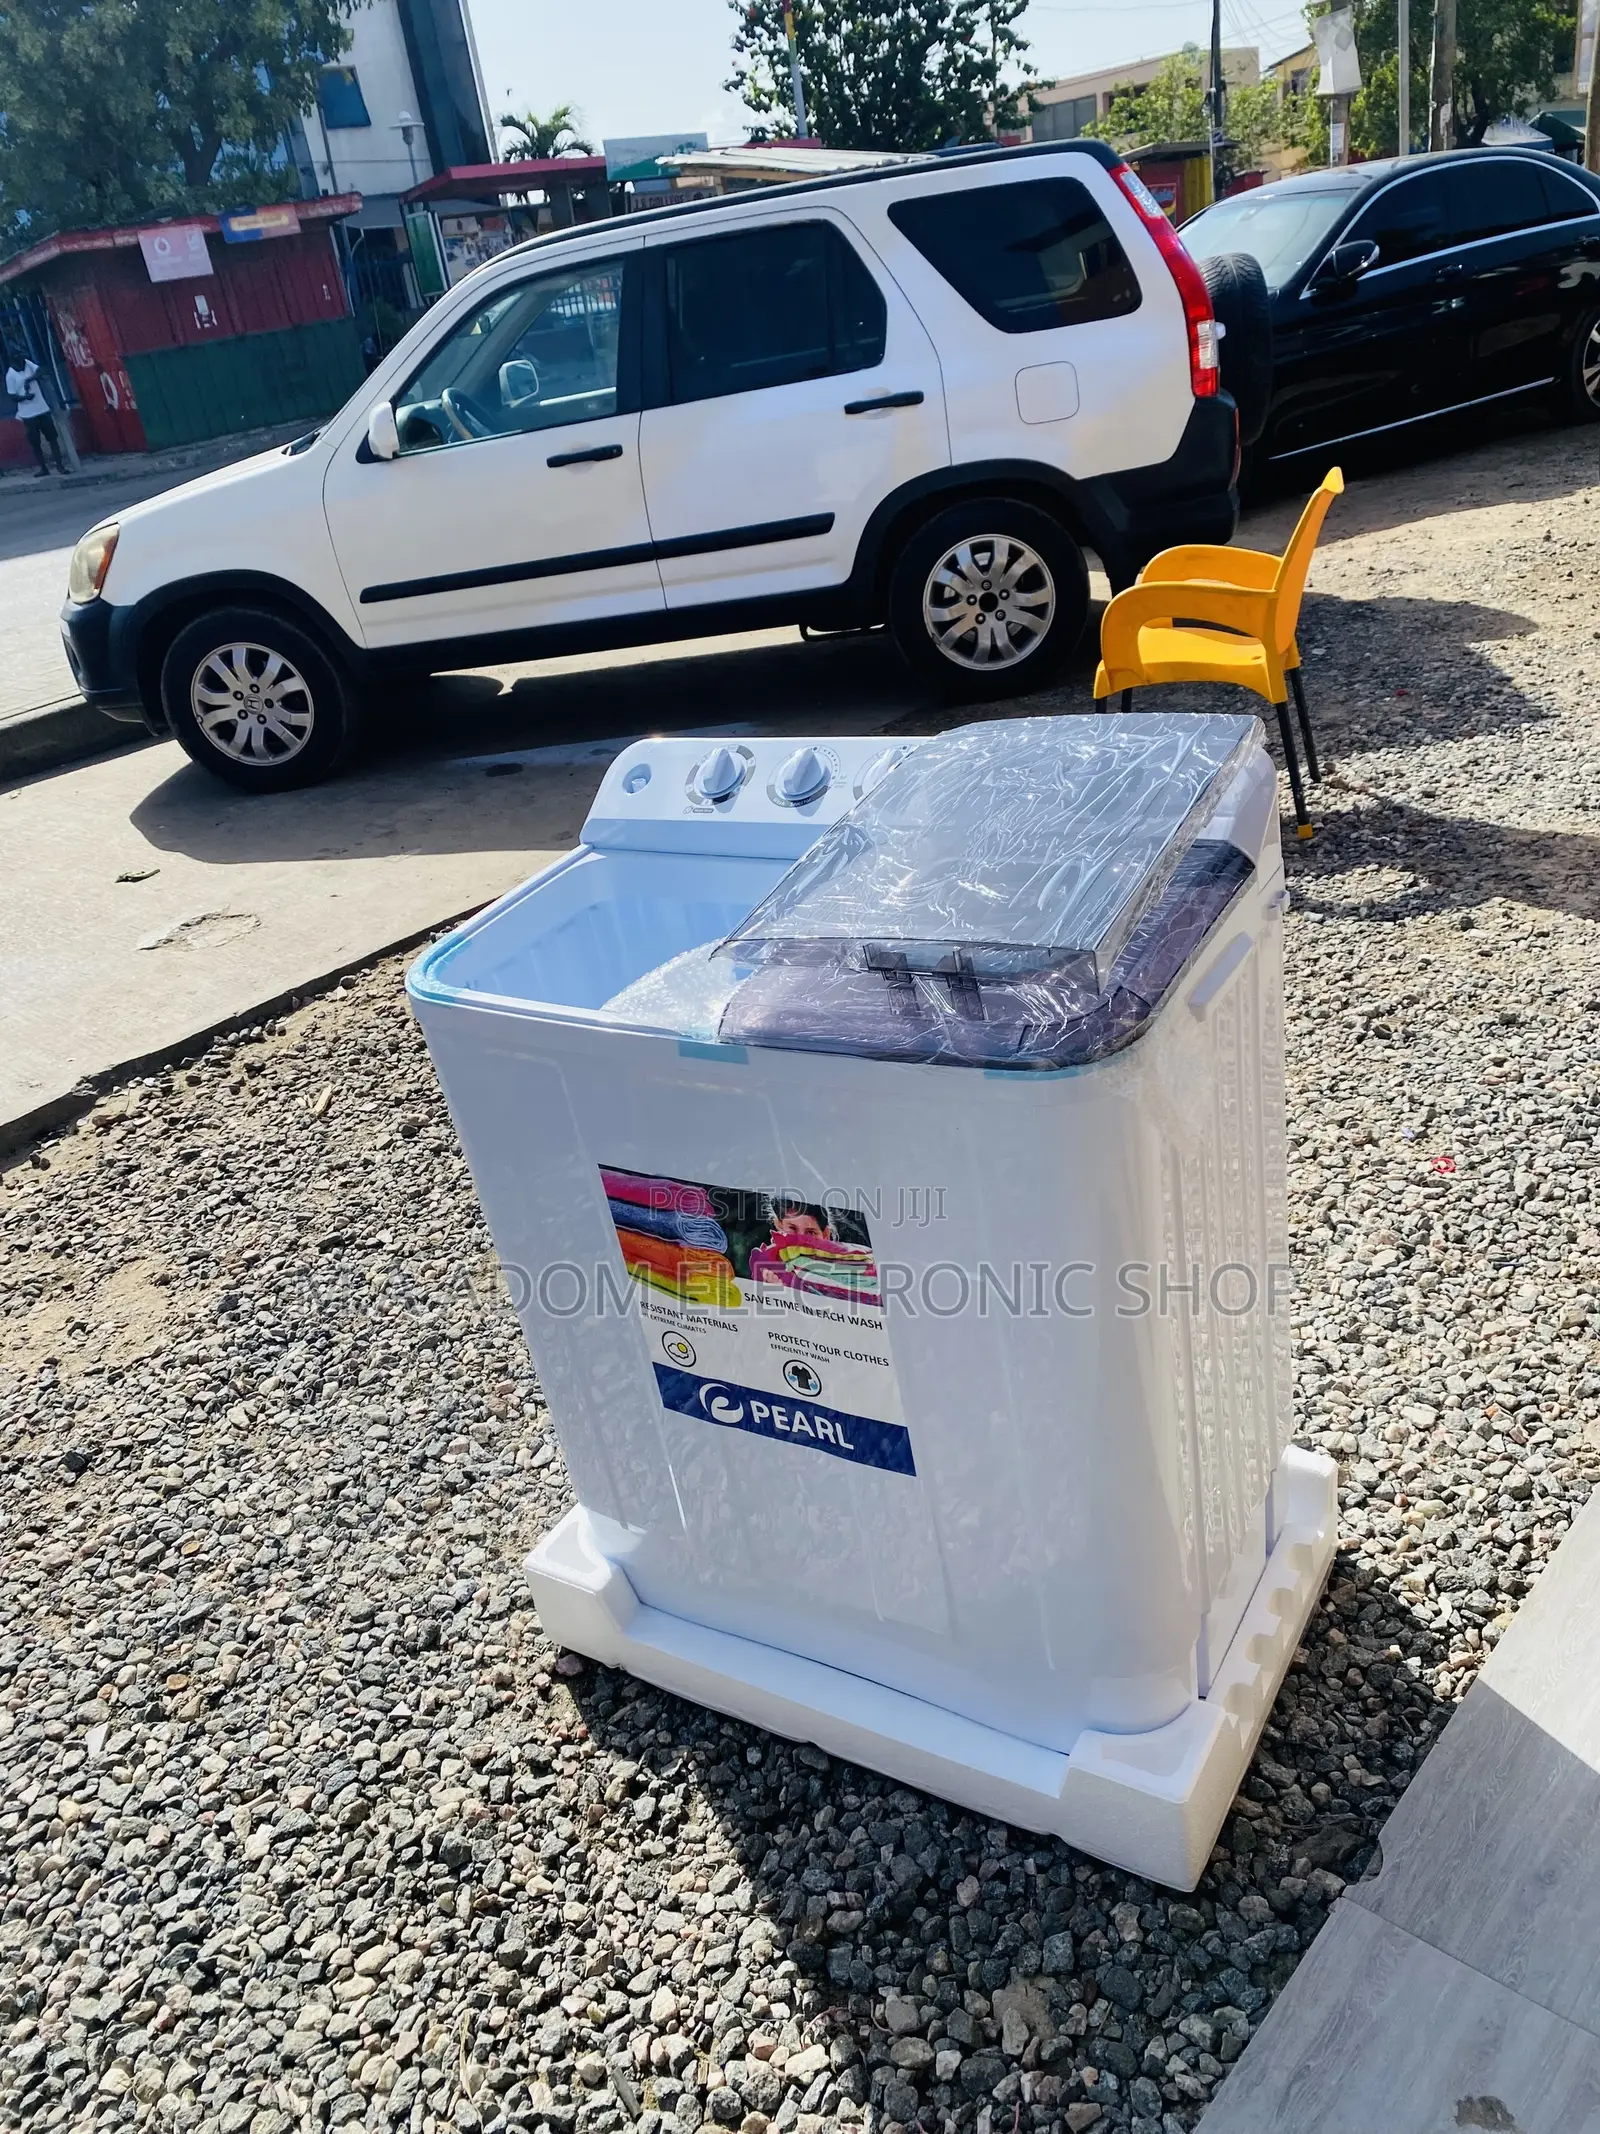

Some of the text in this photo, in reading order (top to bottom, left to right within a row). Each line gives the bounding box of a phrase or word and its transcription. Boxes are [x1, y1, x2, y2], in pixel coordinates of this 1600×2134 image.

[640, 1301, 739, 1333] RESISTANT MATERIALS
[650, 1314, 676, 1327] EXTREME
[676, 1322, 707, 1334] CLIMATES
[744, 1292, 884, 1330] SAVE TIME IN EACH WASH
[768, 1331, 890, 1367] PROTECT YOUR CLOTHES
[770, 1343, 830, 1363] EFFICIENTLY WASH
[750, 1400, 855, 1450] PEARL
